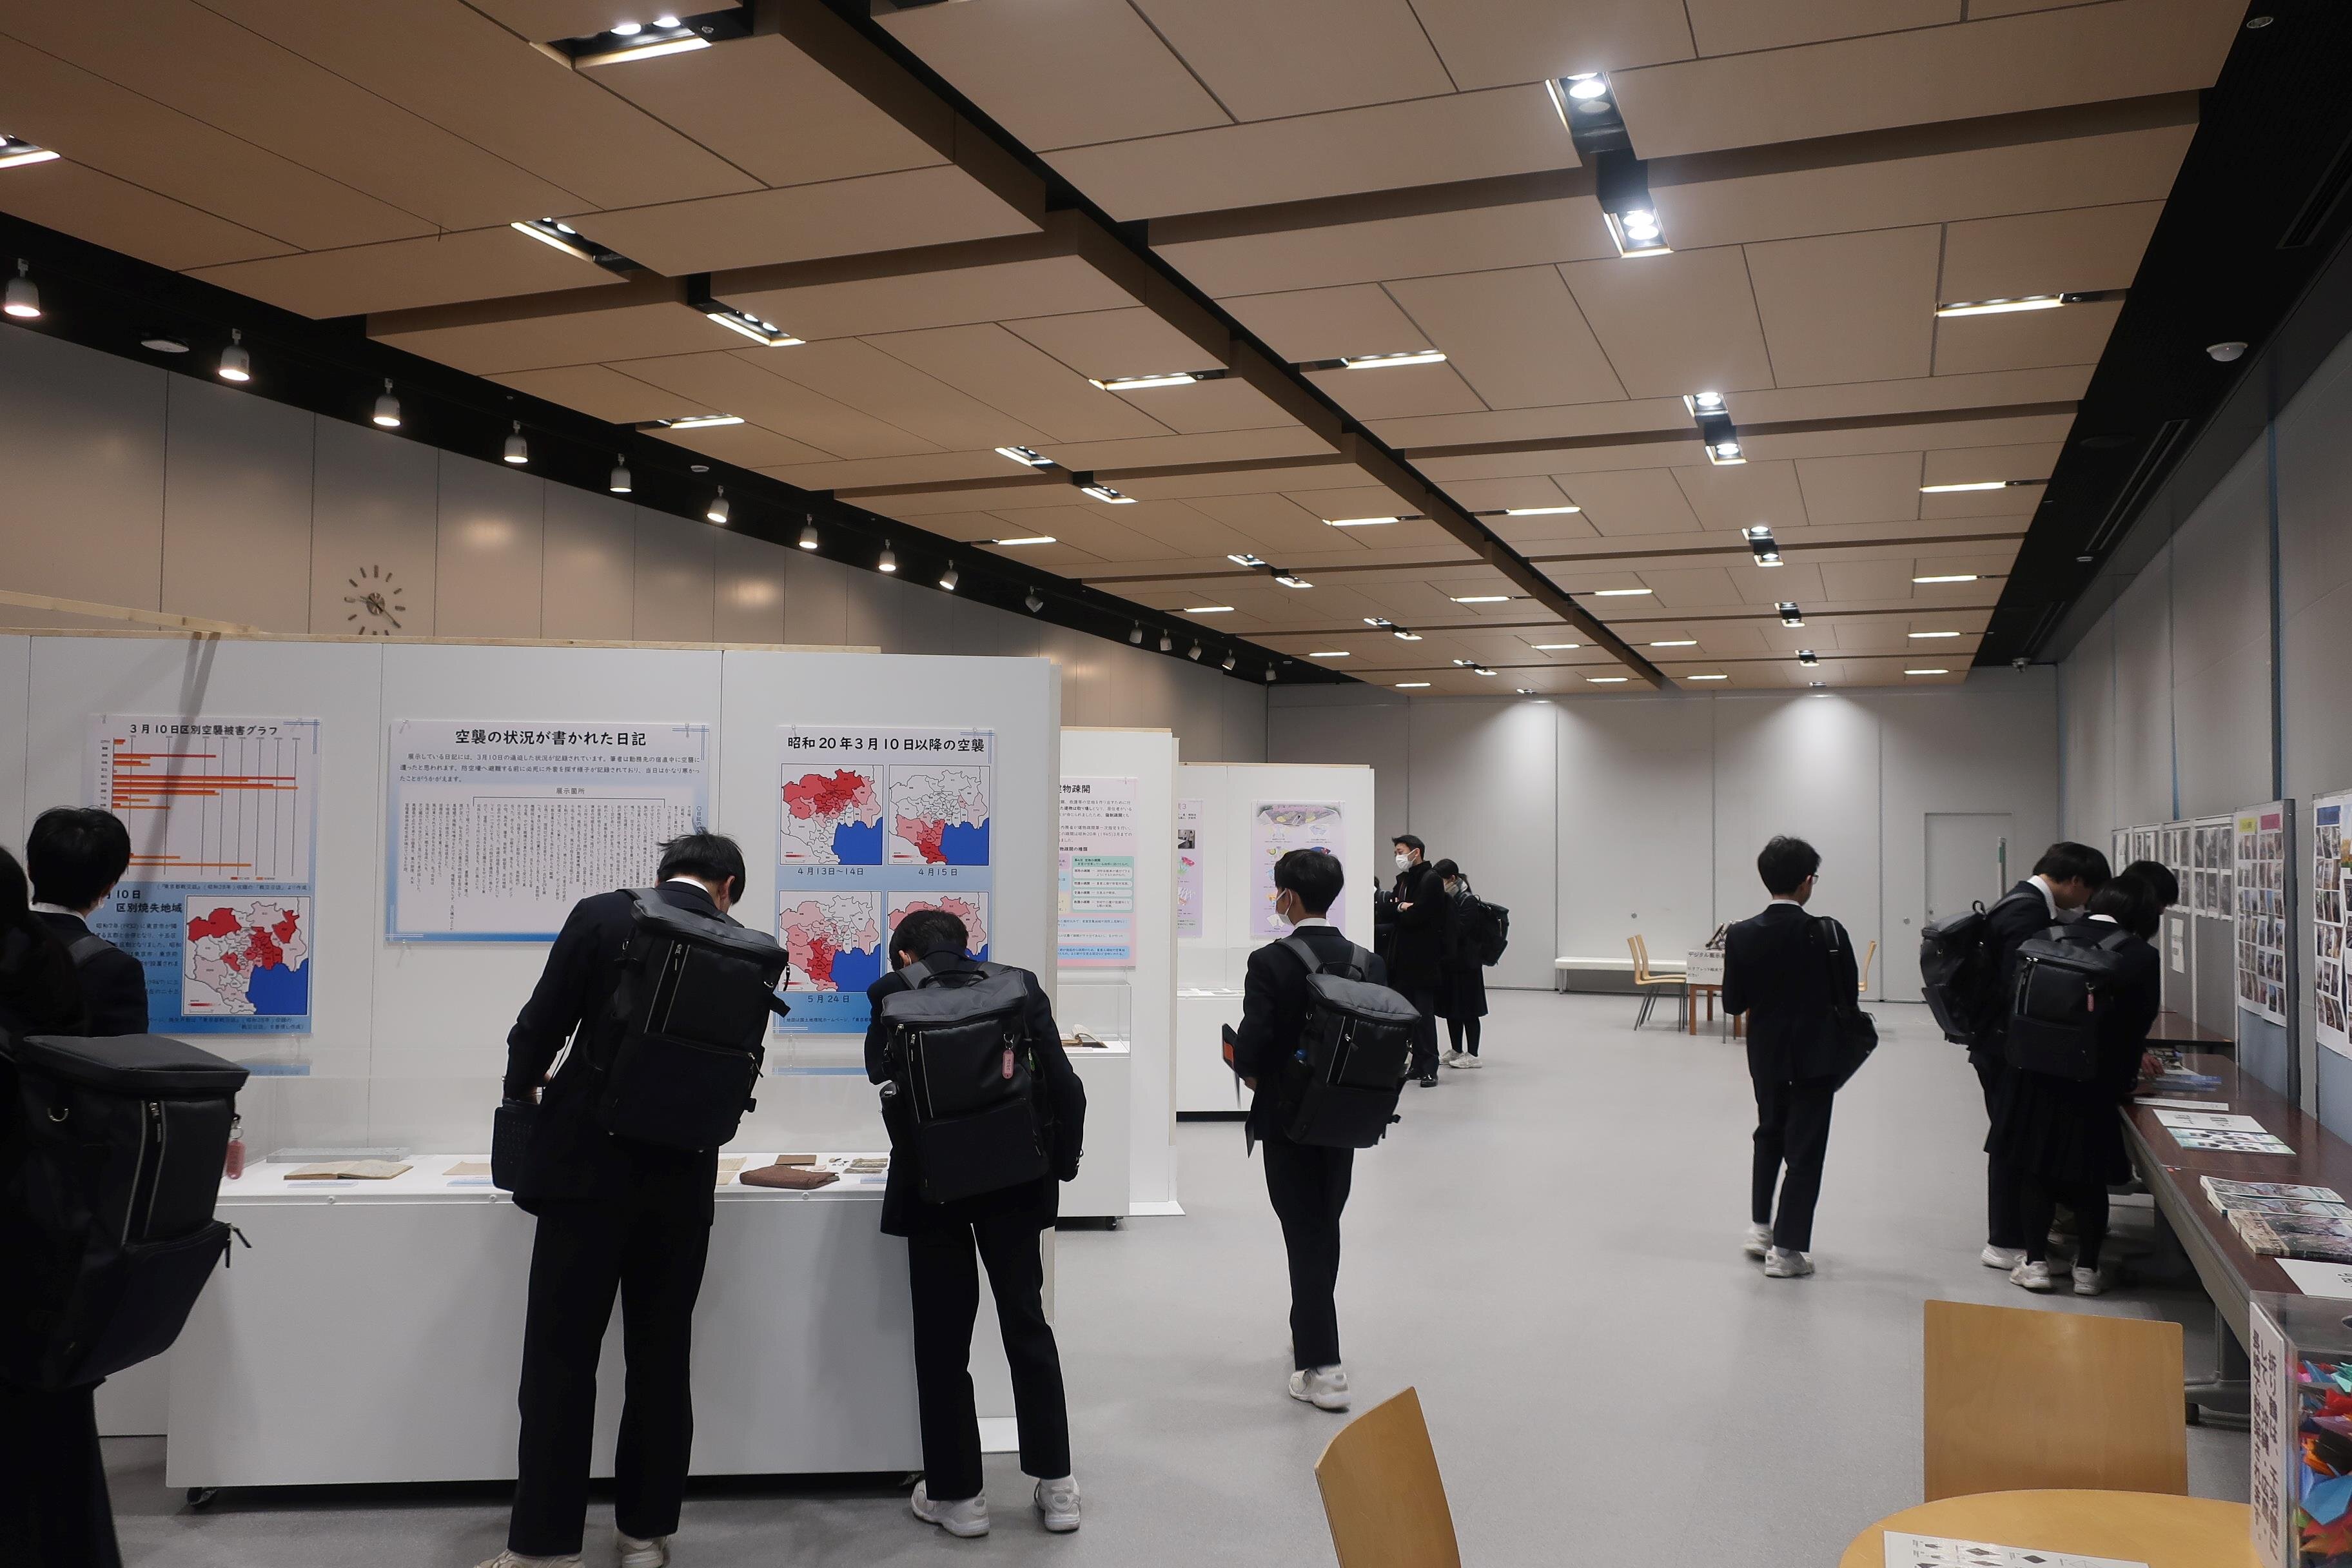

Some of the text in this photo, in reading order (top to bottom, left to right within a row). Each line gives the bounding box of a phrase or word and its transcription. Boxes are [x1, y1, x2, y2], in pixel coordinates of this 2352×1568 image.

[130, 724, 278, 736] 3月10日区別空襲被害グラフ
[455, 729, 646, 745] 空襲の状況が書かれた日記
[788, 736, 985, 752] 昭和20年3月10日以降の空襲
[1059, 785, 1090, 793] 物疎開
[107, 890, 141, 899] 10日
[116, 903, 182, 914] 区別焼失地域
[807, 995, 850, 1003] 5月24日
